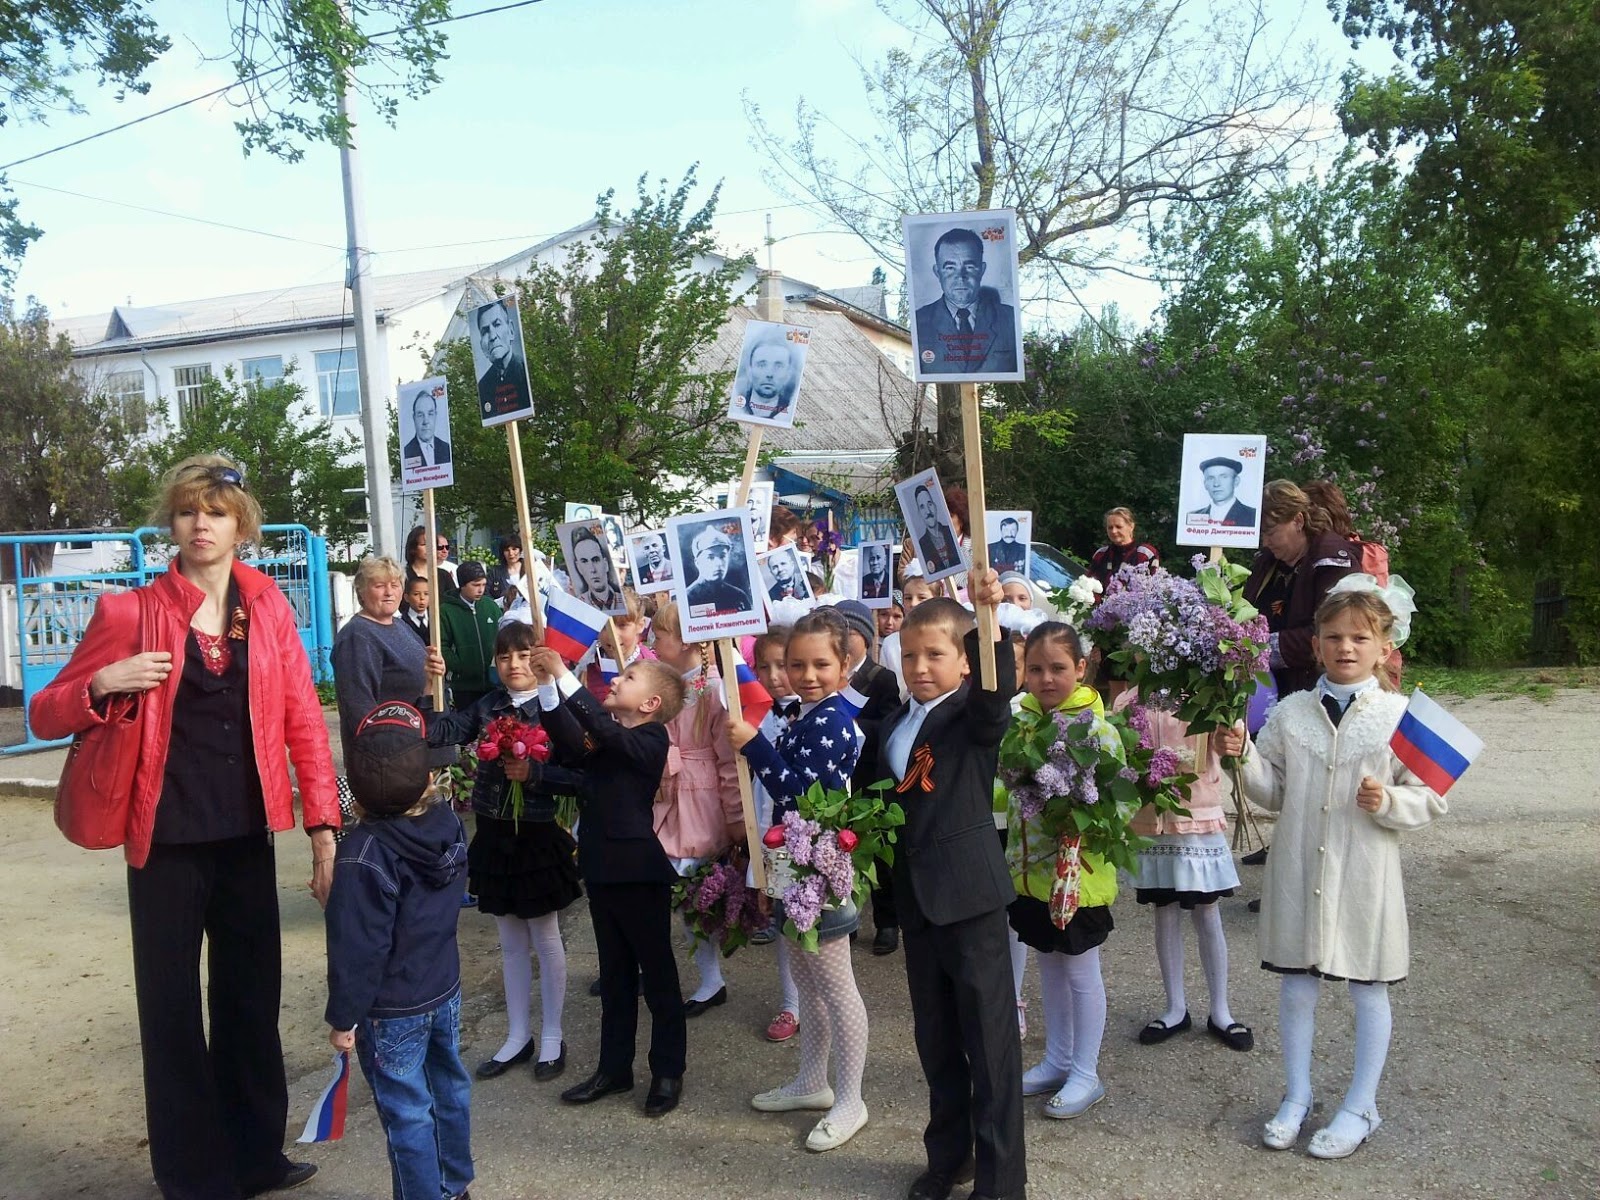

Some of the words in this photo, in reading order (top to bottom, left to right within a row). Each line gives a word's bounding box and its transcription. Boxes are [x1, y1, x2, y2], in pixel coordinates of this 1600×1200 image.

[1186, 527, 1209, 536] Фёдор
[1210, 528, 1256, 536] Дмитриевич
[688, 624, 715, 633] Леонтий
[715, 618, 761, 630] Климентьевич
